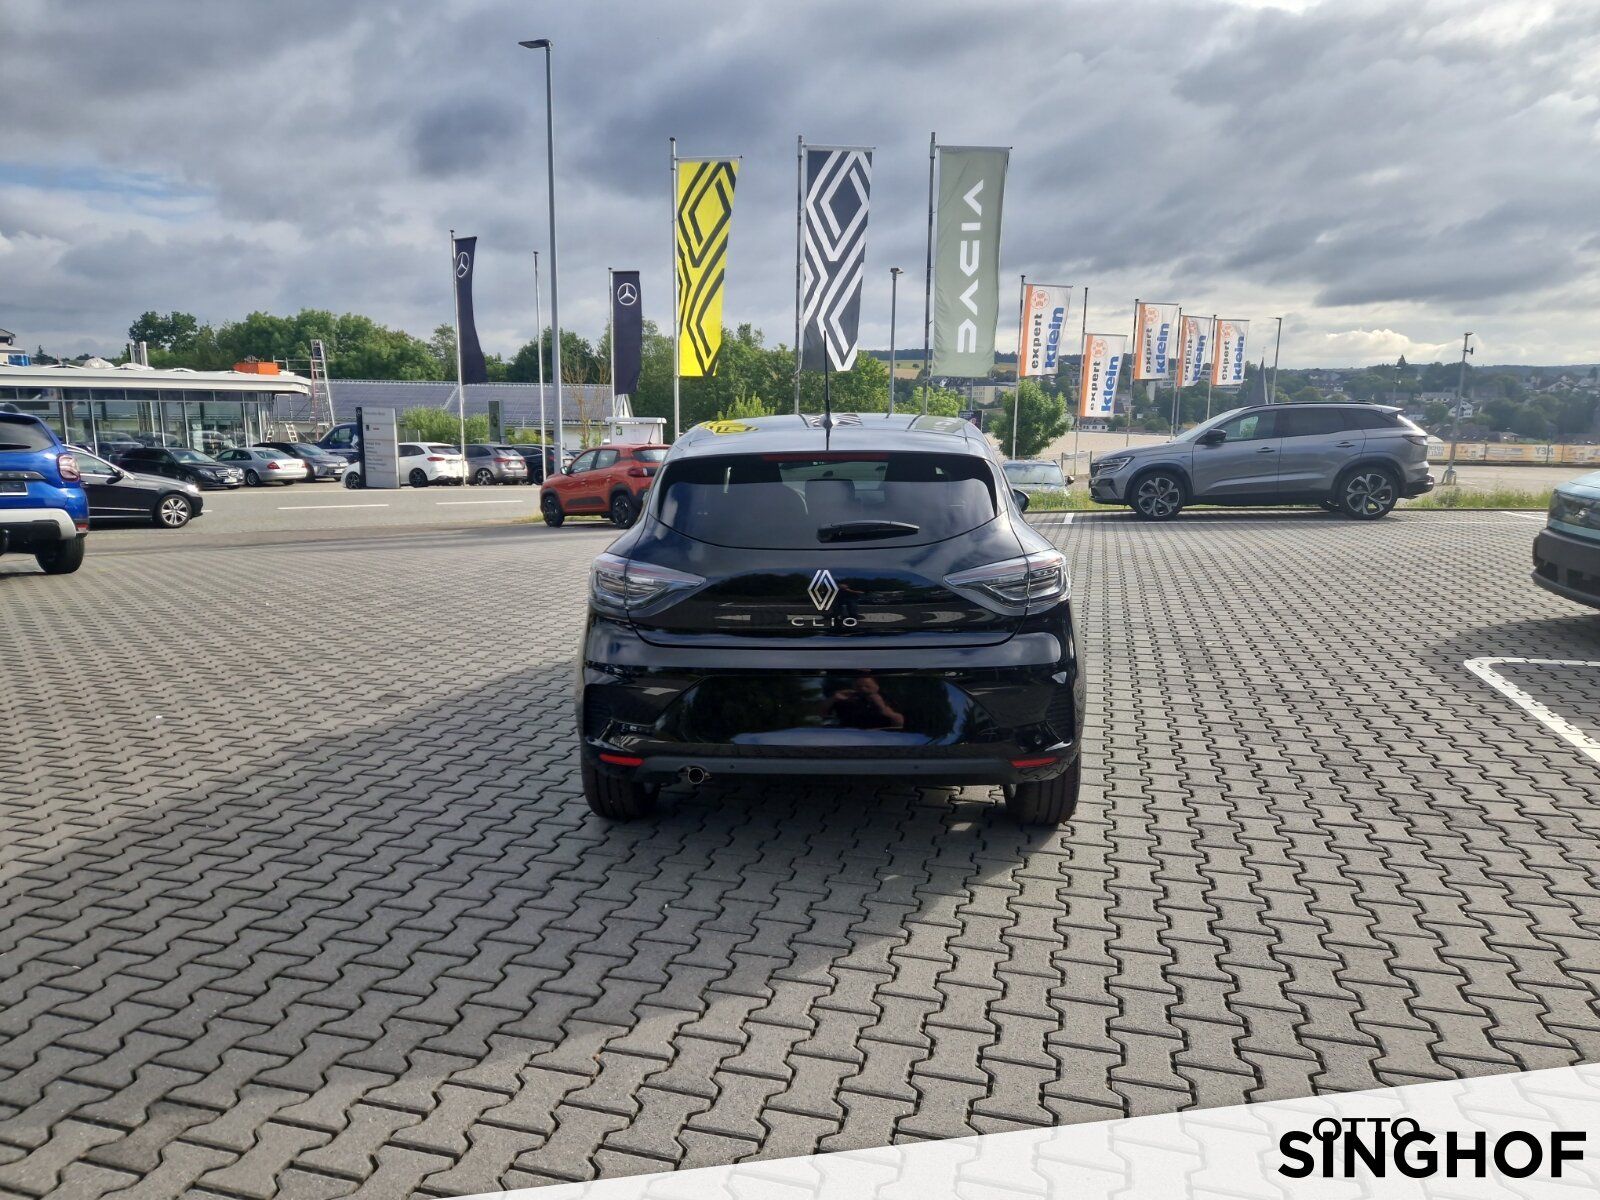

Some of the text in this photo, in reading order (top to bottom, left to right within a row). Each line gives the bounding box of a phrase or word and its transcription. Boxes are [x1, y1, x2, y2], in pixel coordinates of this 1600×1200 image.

[957, 179, 984, 353] DACIA
[1031, 313, 1043, 369] expert
[1044, 307, 1065, 368] klein
[1155, 323, 1170, 374] klein
[1192, 335, 1207, 382] klein
[1221, 341, 1230, 381] expert
[1232, 335, 1245, 381] klein
[1090, 361, 1101, 411] expert
[1101, 356, 1120, 412] klein
[791, 617, 858, 627] CLIO
